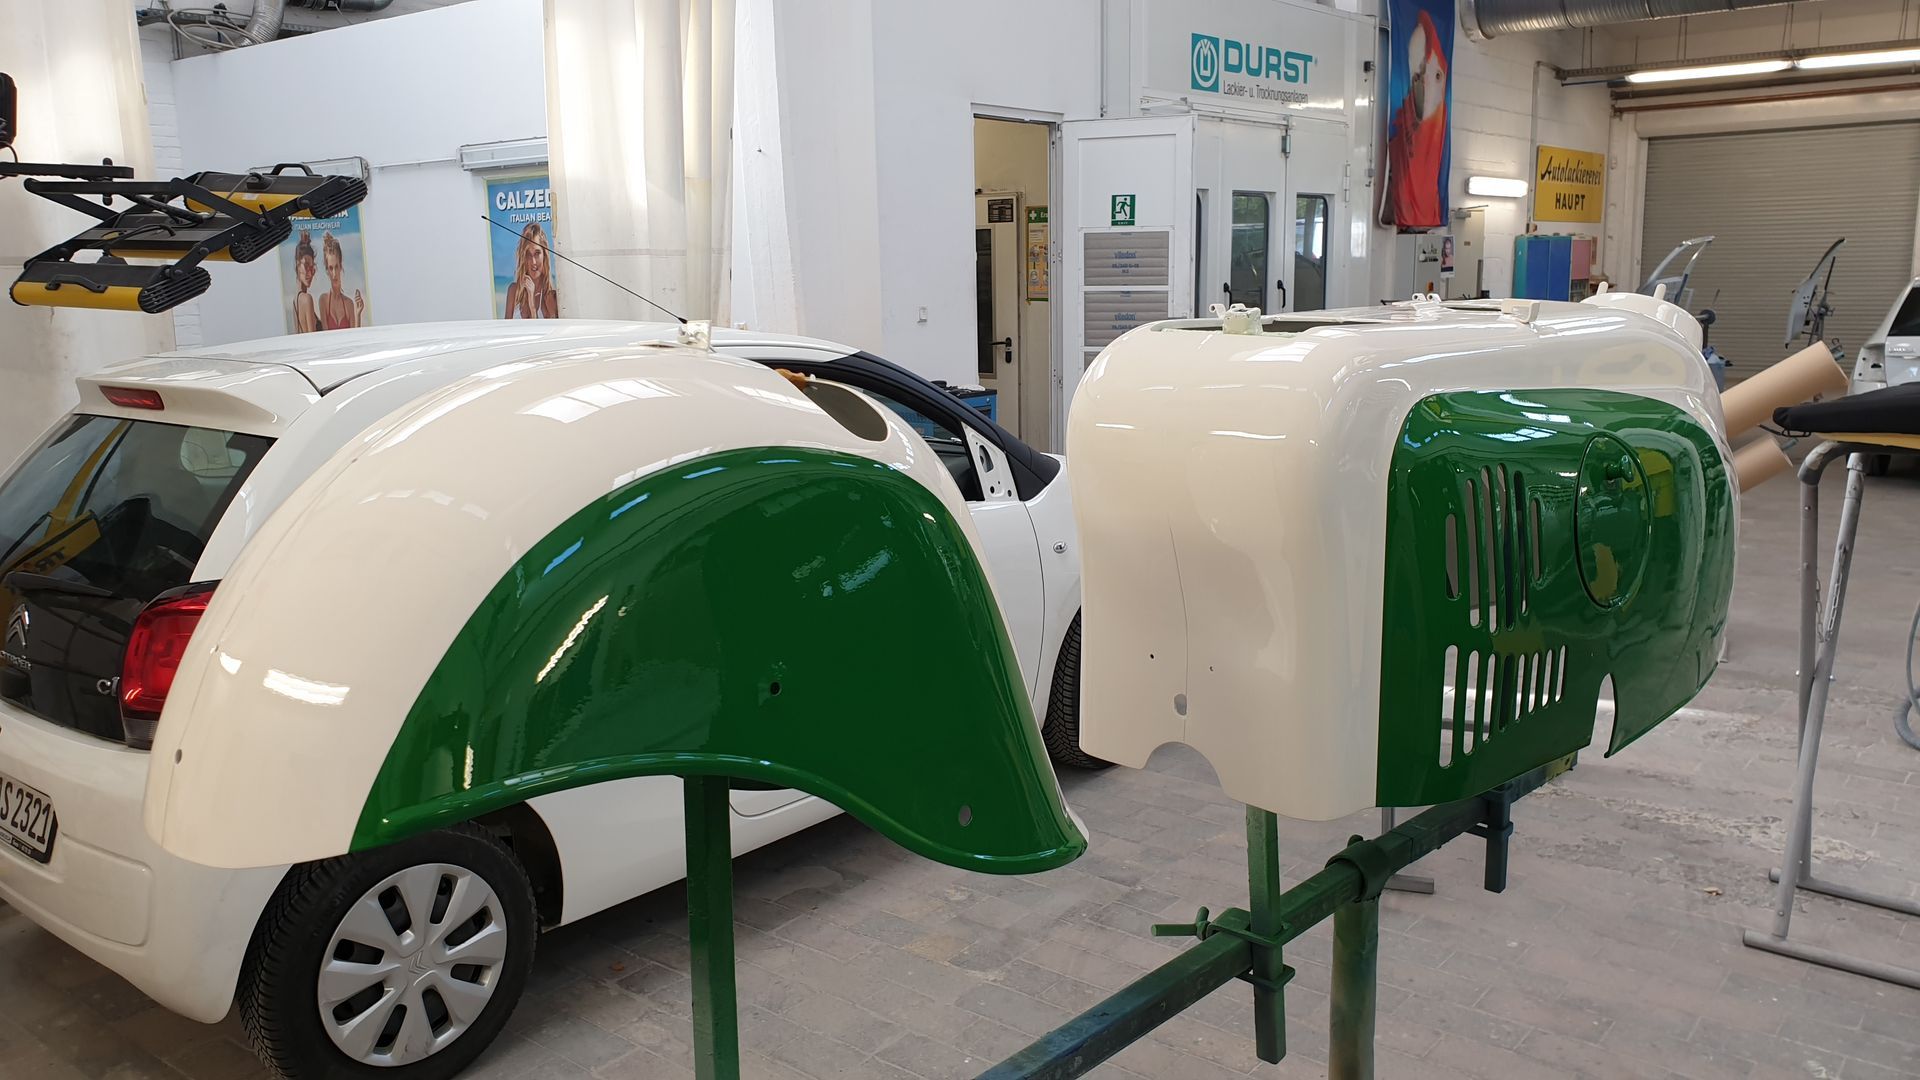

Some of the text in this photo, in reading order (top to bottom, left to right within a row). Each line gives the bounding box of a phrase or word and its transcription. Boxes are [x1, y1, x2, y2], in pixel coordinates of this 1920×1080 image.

[1224, 39, 1313, 84] DURST
[1223, 80, 1248, 96] Lackier-
[1256, 84, 1309, 106] Trocknungsanlagen
[1541, 155, 1601, 185] Autolackiererei
[1555, 192, 1586, 211] HAUPT
[510, 213, 536, 223] ITALIAN
[11, 787, 51, 845] 2321
